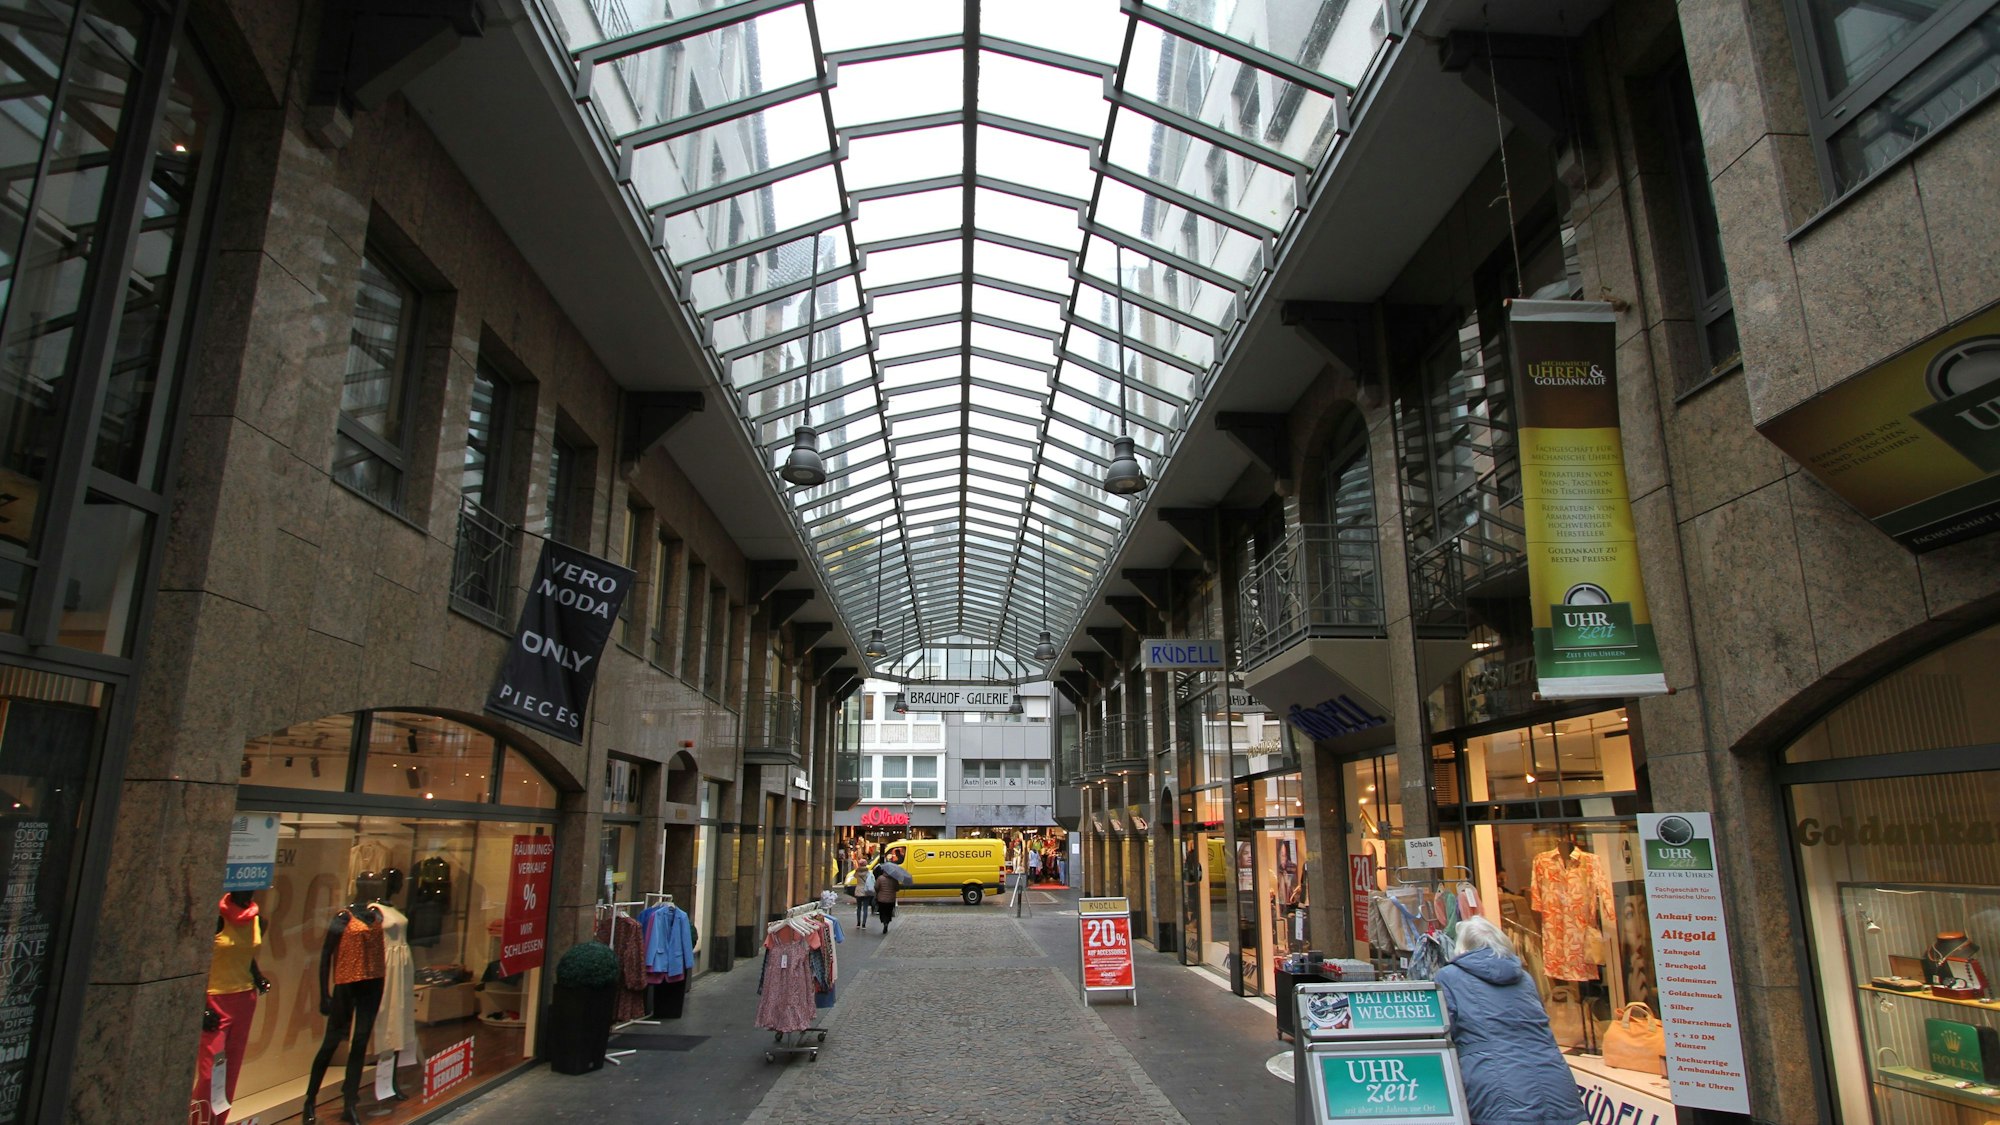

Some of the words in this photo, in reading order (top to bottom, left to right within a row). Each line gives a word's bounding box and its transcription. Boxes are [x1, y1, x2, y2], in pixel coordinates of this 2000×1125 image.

[1528, 364, 1588, 378] UHREN
[1589, 364, 1605, 378] &
[1534, 376, 1607, 386] GOLDANKAUF
[1589, 453, 1619, 461] UHREN
[1541, 504, 1595, 512] REPARATUREN
[1548, 521, 1613, 529] HOCHWERTIGER
[1547, 547, 1605, 555] GOLDANKAUF
[551, 557, 617, 595] VERO
[536, 578, 609, 620] MODA
[1563, 611, 1611, 628] UHR
[1577, 622, 1617, 640] zeit
[521, 629, 593, 673] ONLY
[1151, 643, 1220, 664] RÜDELL
[910, 691, 961, 705] BRAUHOF
[966, 692, 1009, 705] GALERIE
[499, 683, 580, 729] PIECES
[1798, 812, 2000, 847] Goldanka
[1409, 840, 1434, 849] Schals
[11, 852, 43, 860] HOLZ
[938, 850, 993, 859] PROSEGUR
[1658, 847, 1693, 860] UHR
[517, 862, 548, 875] VERKAUF
[1655, 886, 1700, 894] Fachgeschäft
[1695, 893, 1716, 901] Uhren
[1655, 912, 1693, 922] Ankauf
[1694, 914, 1718, 922] von:
[519, 923, 534, 936] WIR
[1087, 919, 1127, 947] 20%
[1660, 929, 1717, 943] Altgold
[503, 940, 544, 960] SCHLIESSEN
[1663, 948, 1701, 957] Zahngold
[1665, 962, 1707, 971] Bruchgold
[1354, 990, 1432, 1005] BATTERIE-
[1668, 989, 1724, 1000] Goldschmuck
[1355, 1004, 1436, 1020] WECHSEL
[1669, 1003, 1695, 1012] Silber
[1671, 1017, 1733, 1029] Silberschmuck
[1676, 1056, 1729, 1068] hochwertige
[1931, 1052, 1980, 1073] ROLEX
[1345, 1058, 1410, 1084] UHR
[1677, 1065, 1742, 1078] Armbanduhren
[1366, 1077, 1420, 1104] zeit
[1707, 1082, 1736, 1092] Uhren
